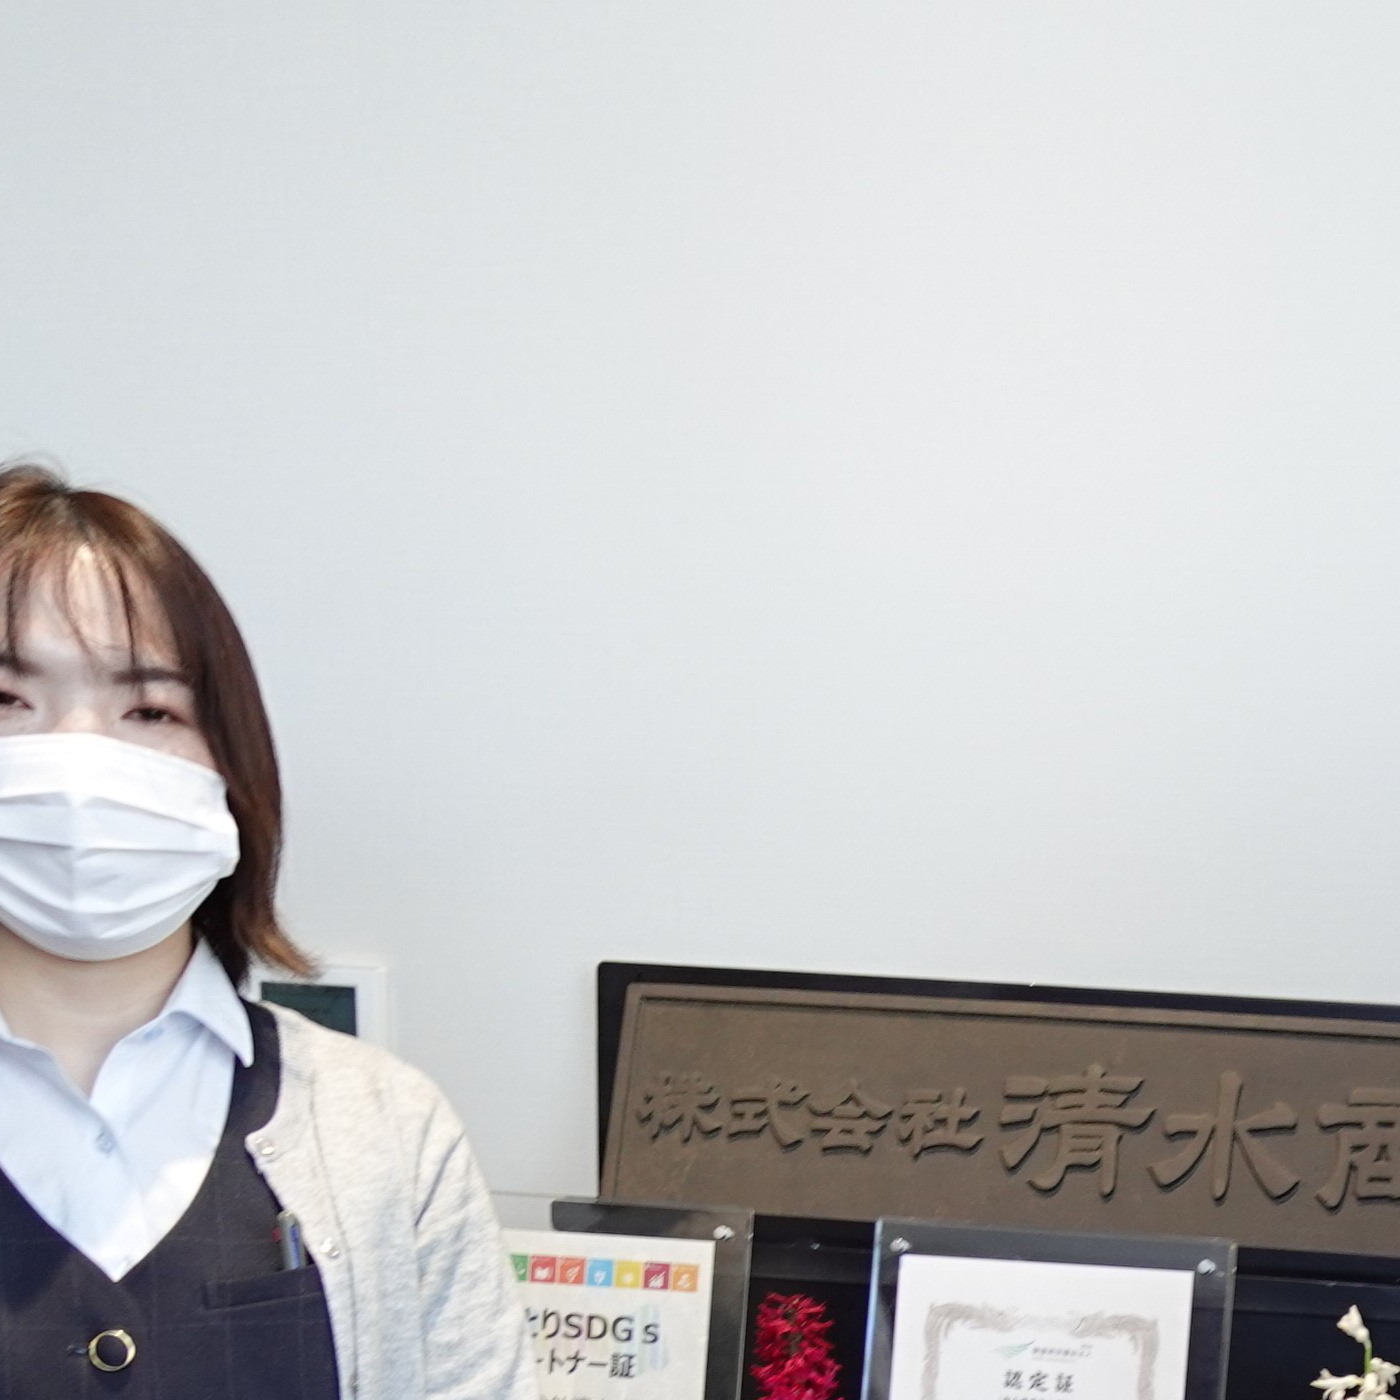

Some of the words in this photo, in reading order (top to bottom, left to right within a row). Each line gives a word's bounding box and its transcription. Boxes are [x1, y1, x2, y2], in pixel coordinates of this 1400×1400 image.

[536, 1349, 636, 1379] トナー証
[1003, 1369, 1074, 1393] 認定証
